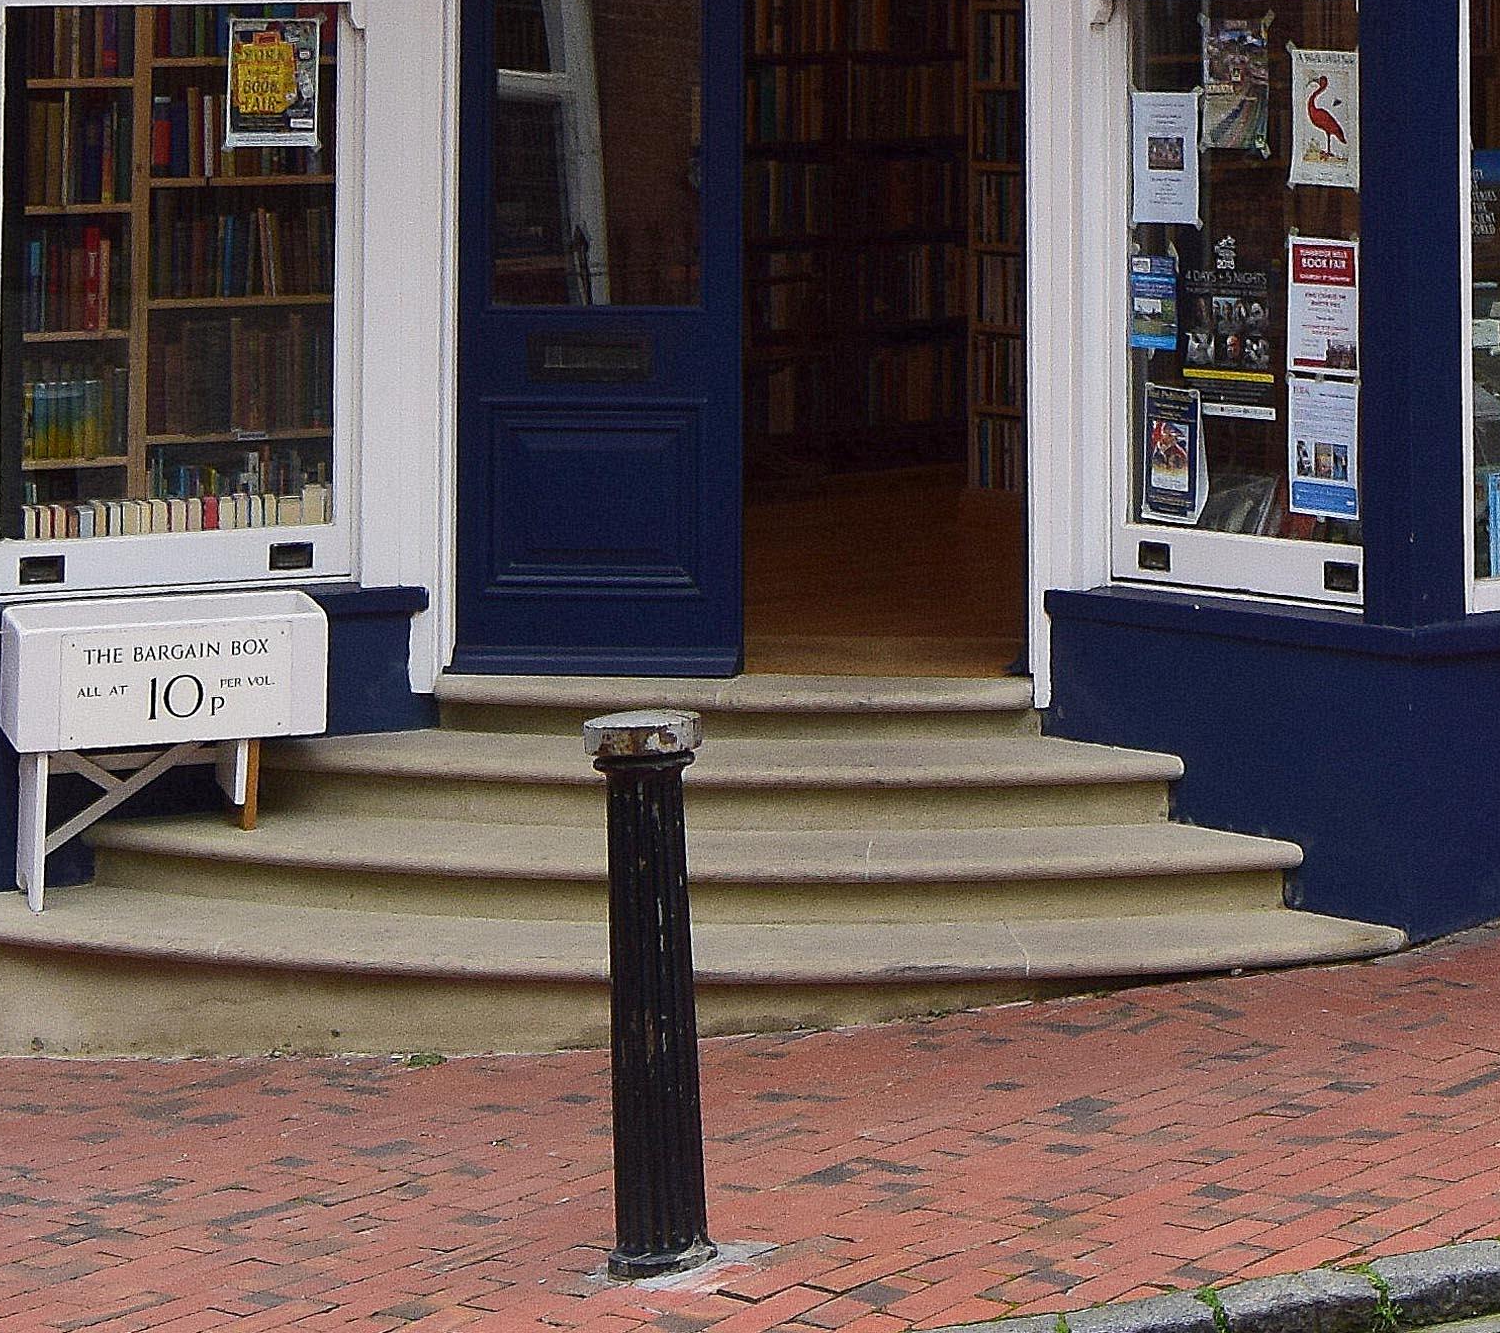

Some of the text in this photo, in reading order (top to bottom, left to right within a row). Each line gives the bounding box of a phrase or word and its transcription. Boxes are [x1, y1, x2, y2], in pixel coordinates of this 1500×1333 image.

[244, 81, 279, 94] BOOK
[1302, 259, 1328, 269] BOOK
[1193, 270, 1216, 283] DAYS
[1234, 271, 1267, 285] NIGHTS
[83, 639, 269, 665] THE BARGAIN BOX
[77, 687, 101, 698] ALL
[109, 685, 128, 696] AT
[220, 678, 242, 688] PER
[248, 676, 275, 686] VOL.
